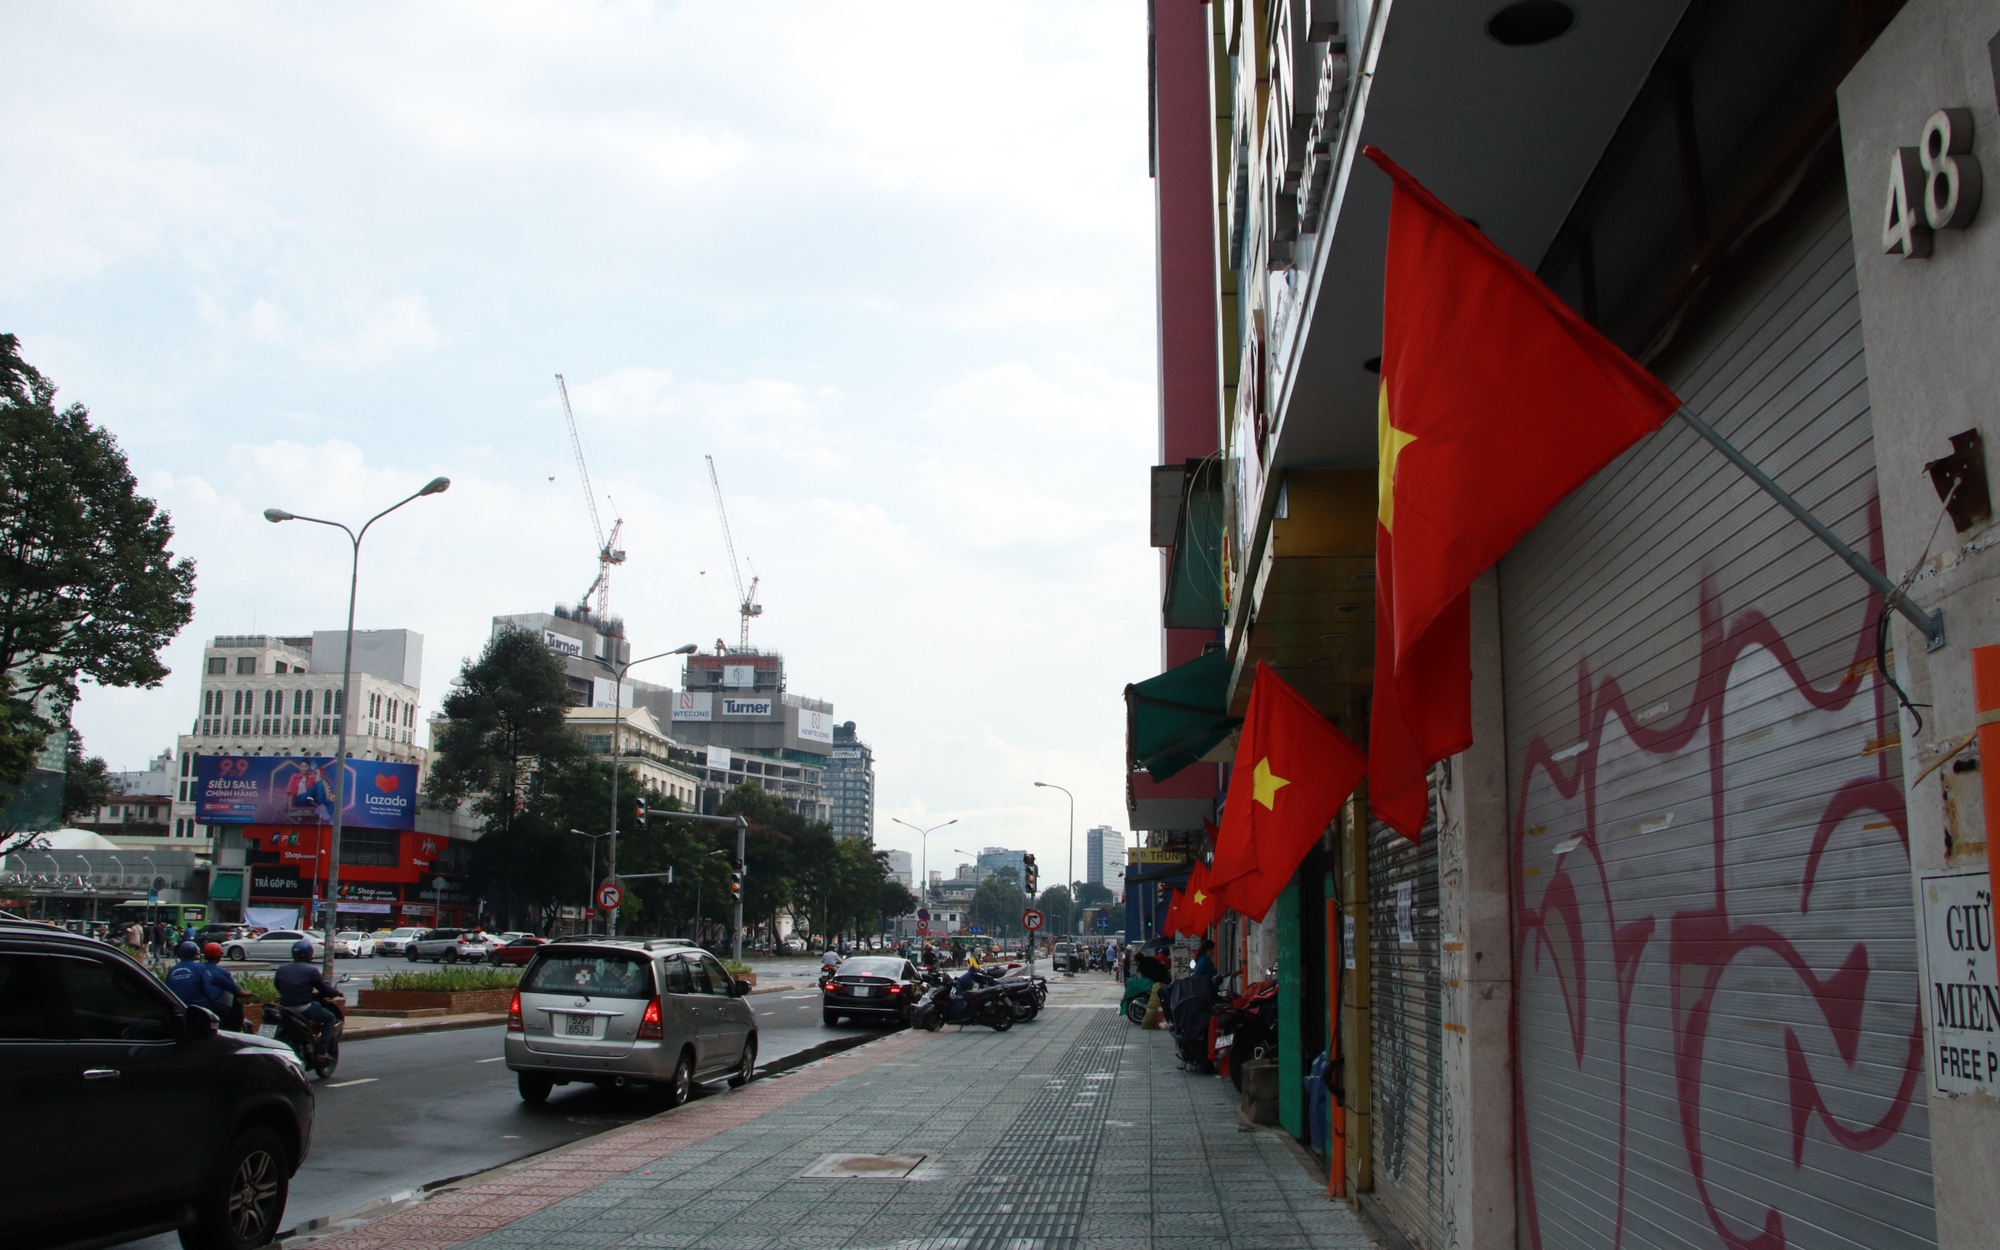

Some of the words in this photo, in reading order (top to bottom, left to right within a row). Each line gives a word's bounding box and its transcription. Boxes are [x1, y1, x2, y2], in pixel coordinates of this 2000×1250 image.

[1882, 108, 1966, 259] 48
[547, 632, 580, 656] Turner
[724, 700, 770, 713] Turner
[673, 710, 710, 718] WTECONS
[801, 728, 830, 739] NEWTECONS
[208, 778, 231, 789] SIÊU
[232, 780, 258, 789] SALE
[205, 789, 232, 797] CHÍNH
[365, 793, 407, 807] Lazada
[271, 831, 299, 845] FPT
[1150, 851, 1185, 861] TRUN
[255, 876, 269, 888] TRẢ
[269, 877, 285, 888] GÓP
[286, 880, 298, 889] 0%
[1946, 889, 1991, 952] GIỮ
[572, 1015, 588, 1025] 52P
[568, 1024, 590, 1035] 6533
[1939, 1045, 1983, 1081] FREE
